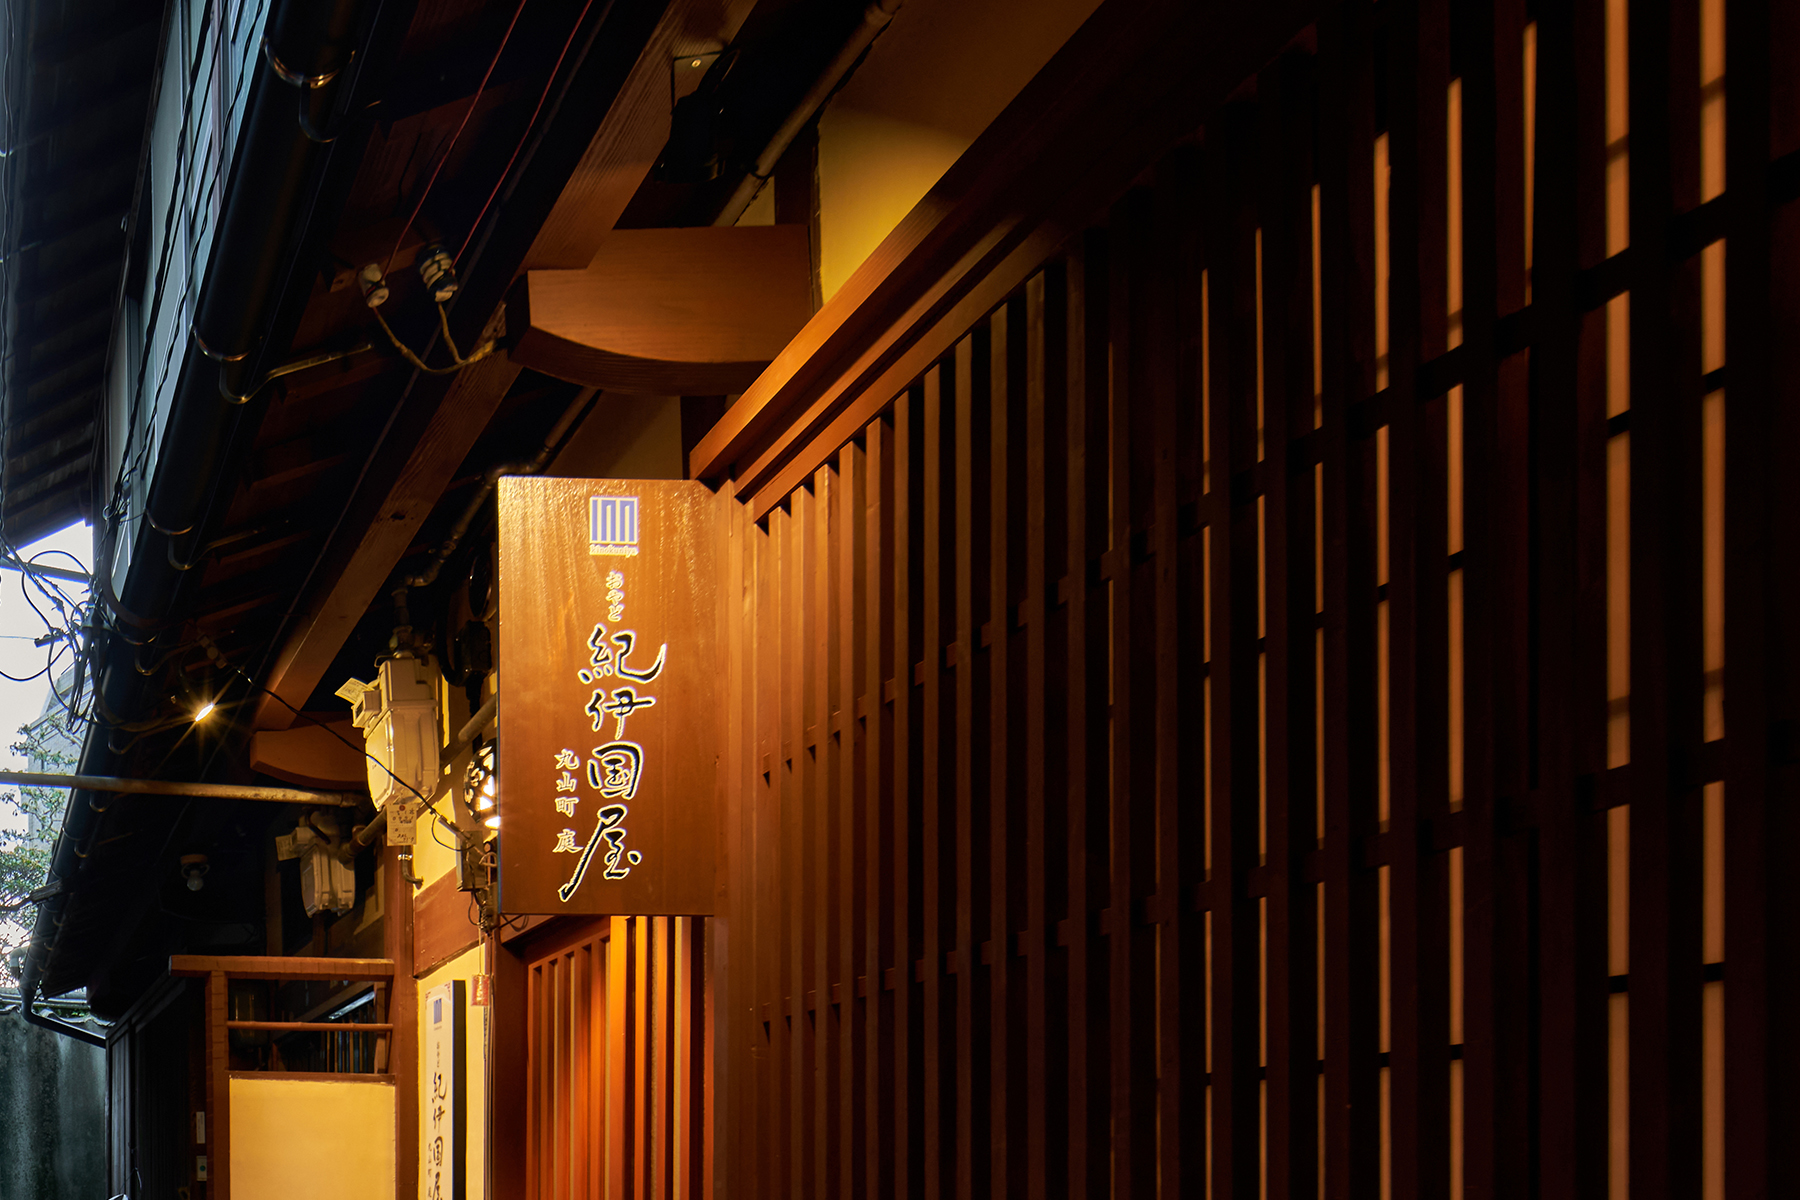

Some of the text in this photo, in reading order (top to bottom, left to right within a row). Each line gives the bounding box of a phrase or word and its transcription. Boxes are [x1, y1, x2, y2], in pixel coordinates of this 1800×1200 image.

[606, 570, 625, 622] おやど
[554, 748, 580, 818] 丸山町
[558, 623, 667, 903] 紀伊国屋
